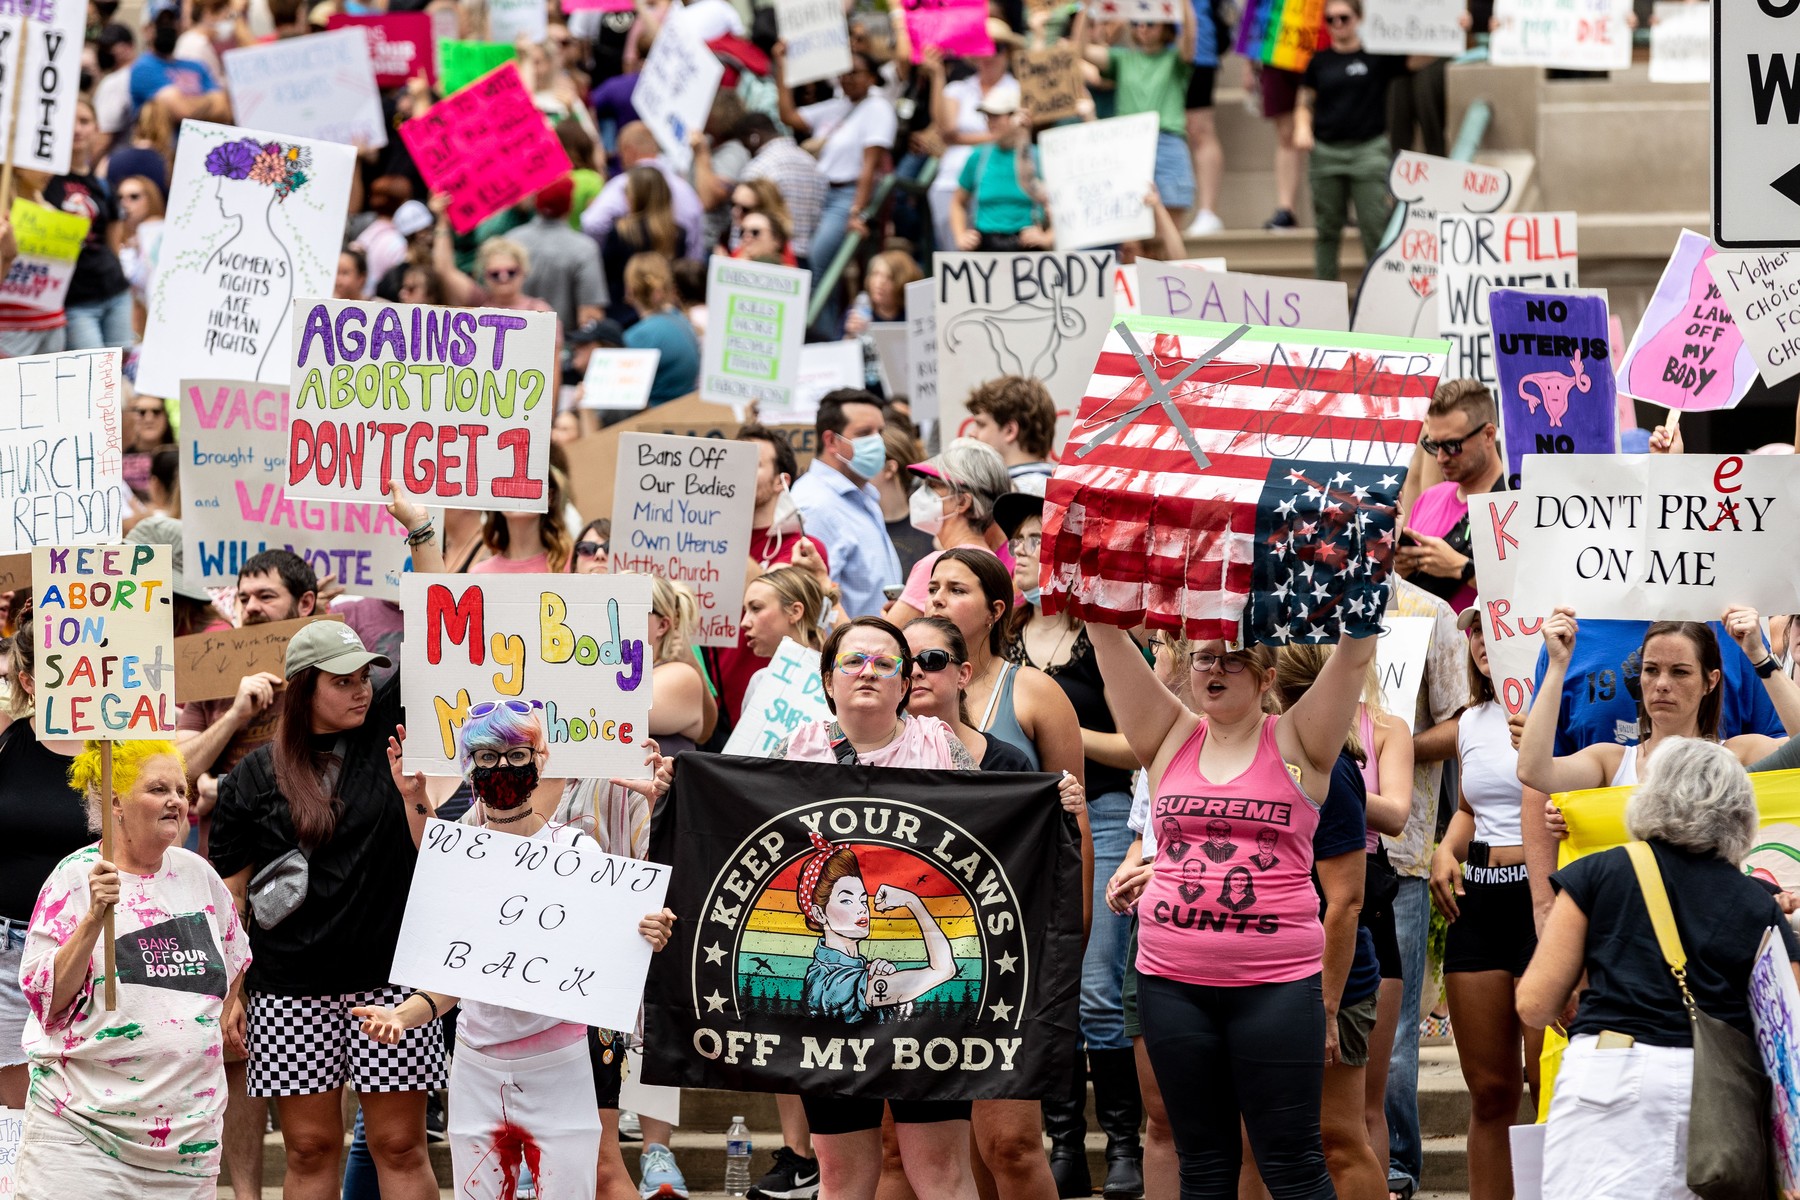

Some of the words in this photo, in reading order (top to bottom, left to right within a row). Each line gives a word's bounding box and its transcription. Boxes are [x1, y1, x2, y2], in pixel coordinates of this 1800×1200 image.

[36, 32, 62, 158] VOTE
[1396, 160, 1430, 185] OUR
[1440, 217, 1502, 266] FOR
[1504, 215, 1578, 264] ALL
[219, 249, 286, 278] WOMEN'S
[941, 259, 998, 303] MY
[1012, 252, 1113, 302] BODY
[1727, 251, 1791, 293] Mother
[219, 273, 269, 296] RIGHTS
[1761, 279, 1775, 291] by
[221, 294, 252, 315] ARE
[1156, 276, 1301, 328] BANS
[1526, 300, 1568, 323] NO
[208, 309, 260, 334] HUMAN
[297, 304, 528, 371] AGAINST
[1685, 323, 1726, 343] OFF
[204, 328, 256, 356] RIGHTS
[1498, 333, 1609, 362] UTERUS
[1682, 343, 1716, 366] MY
[1261, 343, 1433, 399] NEVER
[1662, 356, 1718, 397] BODY
[0, 352, 116, 431] EFT
[296, 361, 545, 421] ABORTION?
[193, 440, 255, 471] brought
[289, 417, 407, 497] DON'T
[402, 420, 489, 498] GET
[490, 427, 543, 500] 1
[638, 443, 682, 467] Bans
[689, 446, 728, 470] Off
[1535, 433, 1575, 455] NO
[195, 495, 220, 508] and
[640, 473, 676, 494] Our
[685, 473, 736, 499] Bodies
[14, 485, 122, 551] REASON
[633, 501, 673, 524] Mind
[677, 499, 721, 526] Your
[1535, 494, 1643, 530] DON'T
[631, 529, 670, 551] Own
[676, 531, 728, 555] Uterus
[50, 544, 155, 576] KEEP
[668, 556, 719, 582] Church
[1576, 546, 1634, 583] ON
[1645, 549, 1716, 587] ME
[38, 580, 171, 612] ABORT-
[426, 583, 526, 697] My
[539, 591, 644, 692] Body
[708, 614, 737, 638] Fate
[45, 653, 142, 689] SAFE
[772, 655, 802, 685] I
[1586, 669, 1617, 705] 19
[45, 693, 175, 735] LEGAL
[433, 688, 473, 760] M
[530, 699, 634, 744] hoice
[1156, 797, 1290, 824] SUPREME
[428, 823, 492, 860] WE
[709, 831, 786, 931] KEEP
[799, 806, 923, 844] YOUR
[932, 830, 1015, 937] LAWS
[498, 894, 566, 931] GO
[1154, 900, 1280, 935] CUNTS
[138, 937, 180, 951] BANS
[142, 950, 171, 964] OFF
[171, 949, 209, 964] OUR
[145, 961, 207, 978] BODIES
[443, 940, 596, 997] BACK
[693, 1027, 782, 1067] OFF
[799, 1036, 876, 1073] MY
[891, 1036, 1023, 1072] BODY
